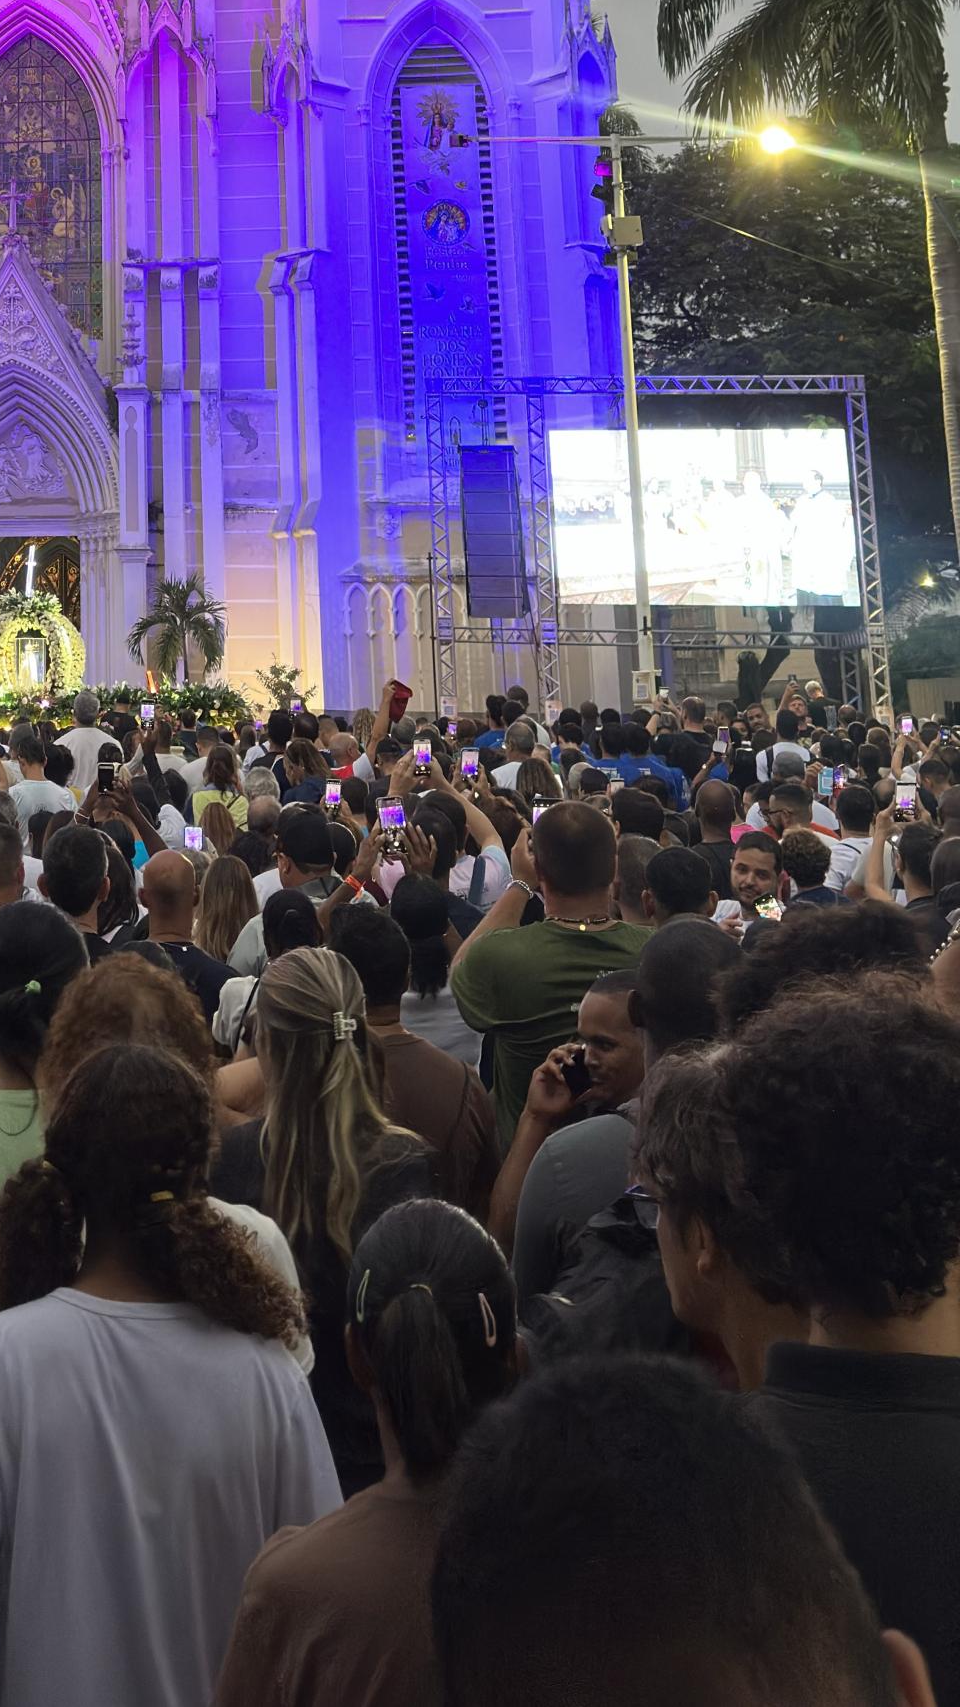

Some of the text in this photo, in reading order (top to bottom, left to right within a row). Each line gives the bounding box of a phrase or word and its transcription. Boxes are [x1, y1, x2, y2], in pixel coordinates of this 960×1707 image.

[419, 325, 482, 339] ROMARIA
[436, 340, 468, 352] DOS
[422, 353, 484, 367] HOMENS
